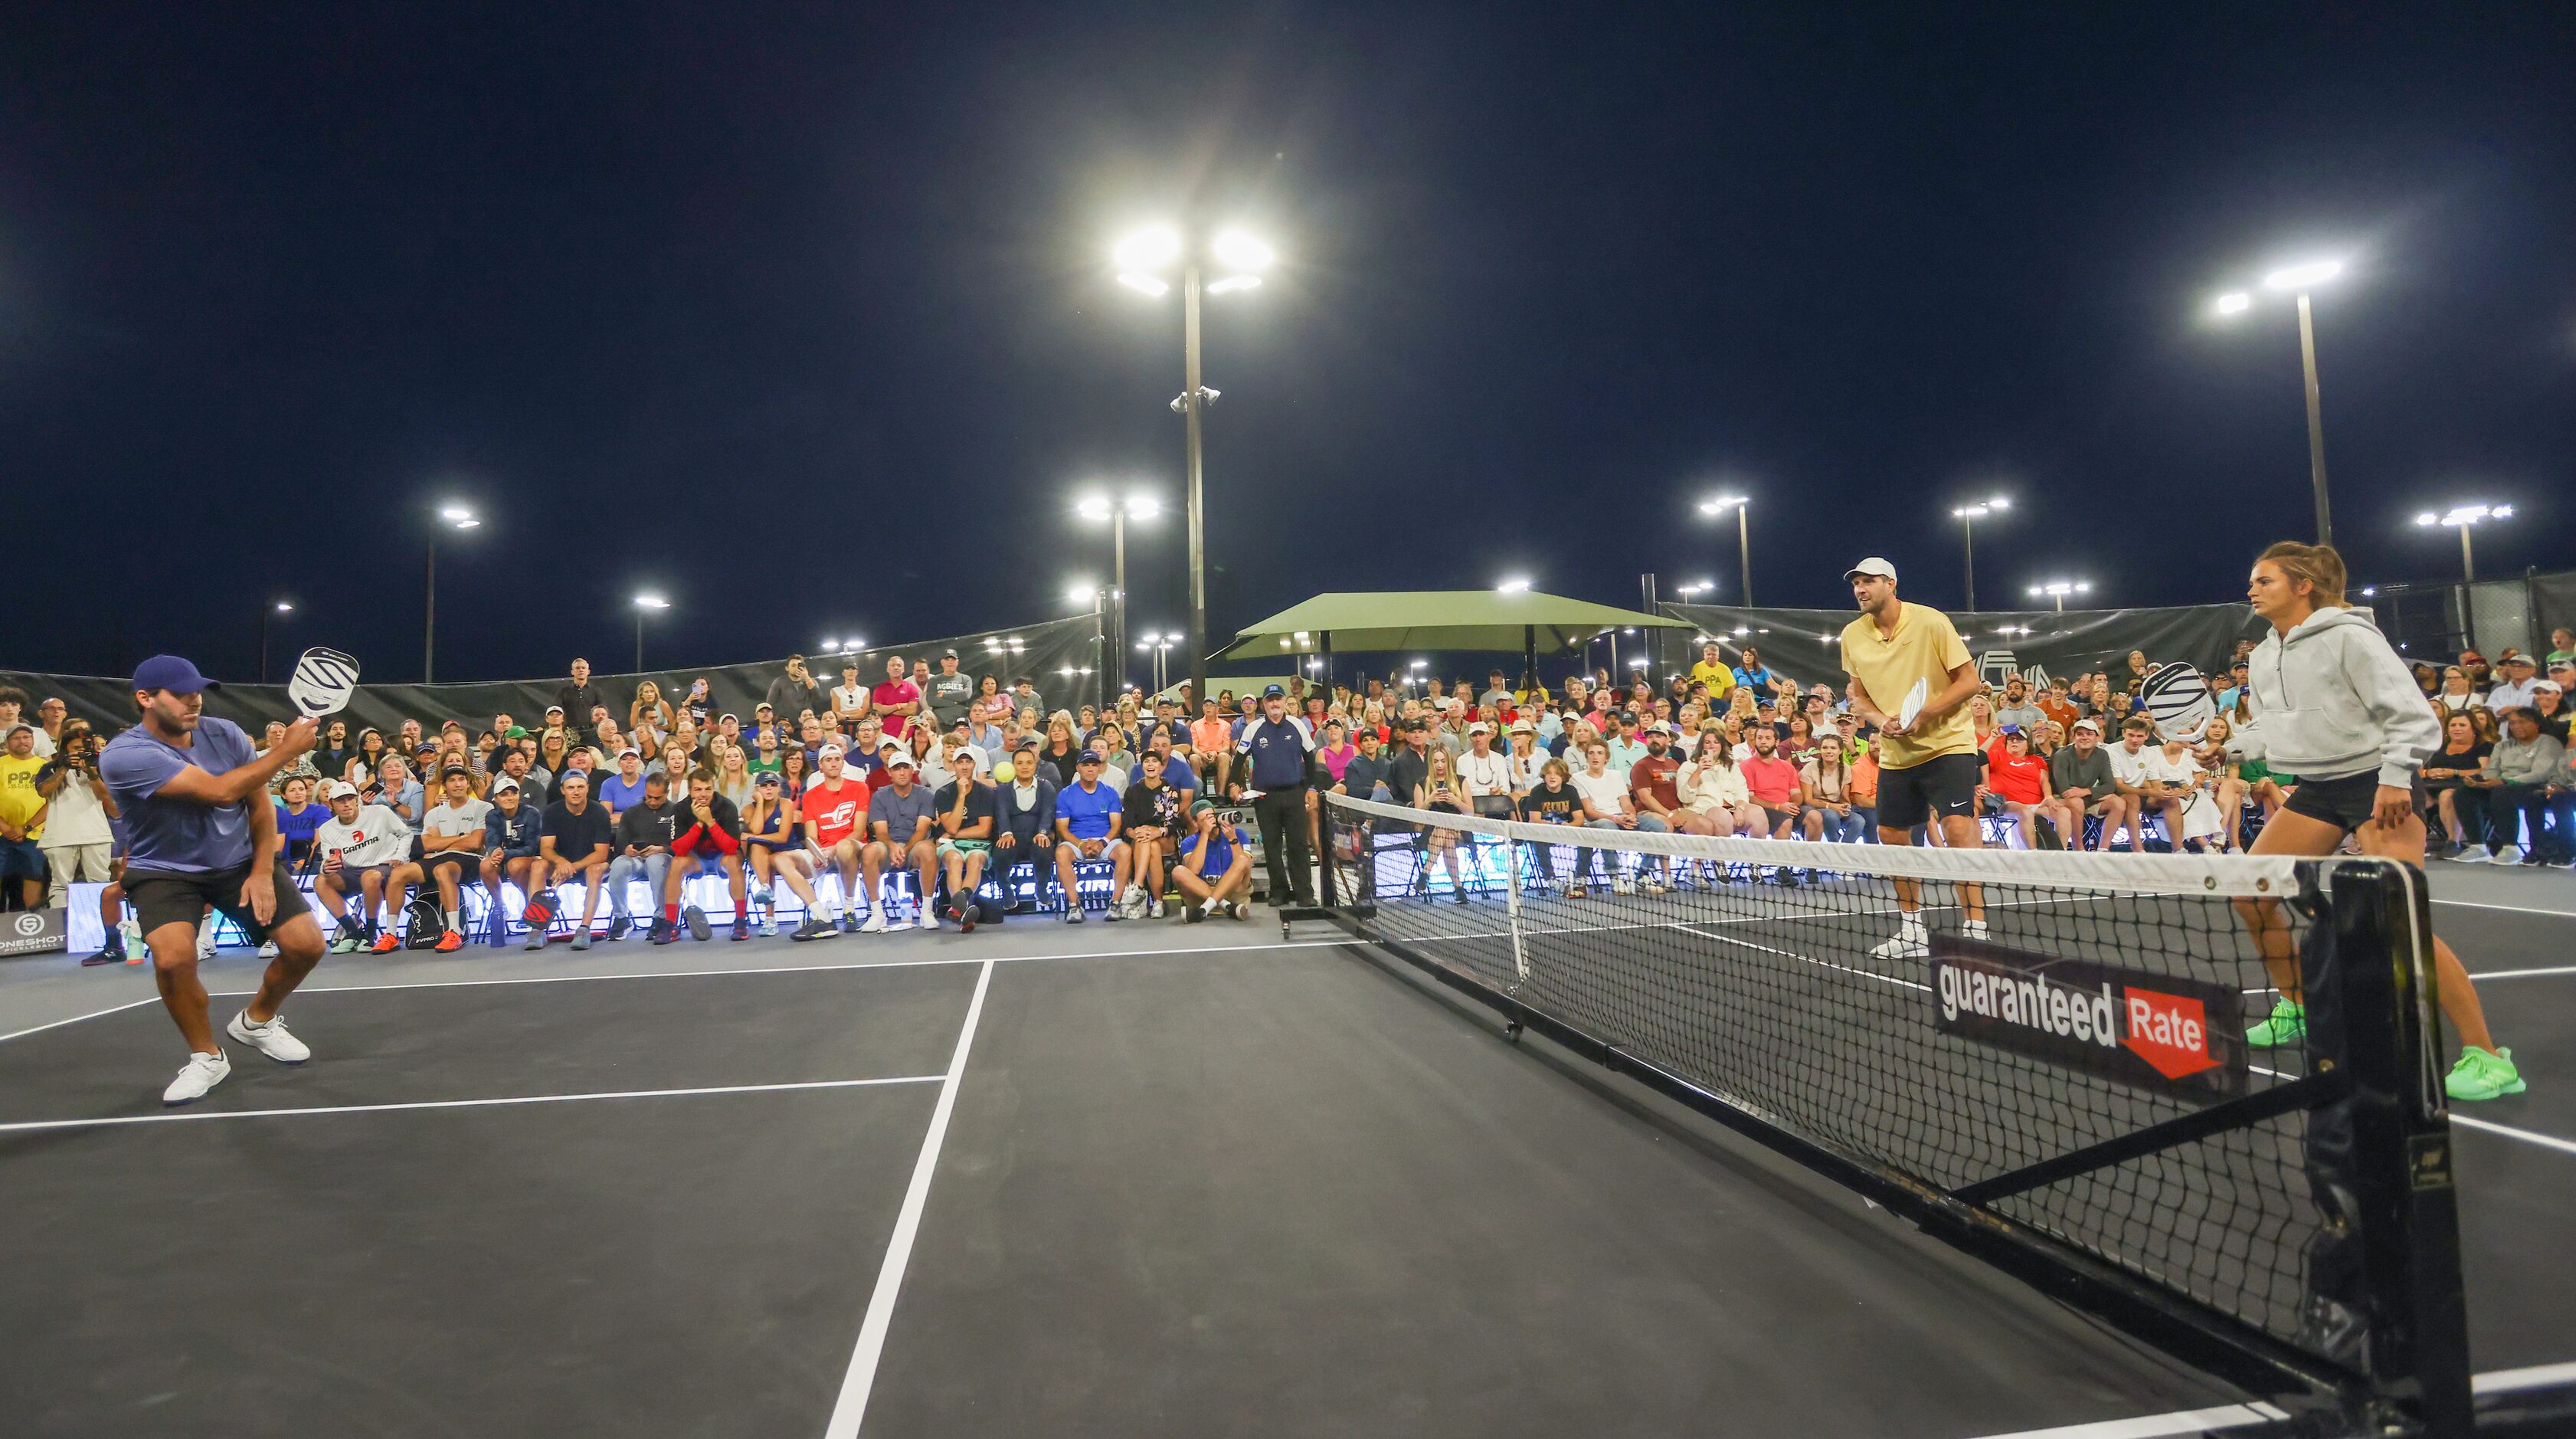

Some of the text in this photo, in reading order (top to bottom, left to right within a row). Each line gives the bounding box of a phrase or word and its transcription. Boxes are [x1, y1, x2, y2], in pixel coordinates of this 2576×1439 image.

[1705, 674, 1722, 684] PPA
[937, 681, 964, 690] AGGIES
[342, 835, 379, 854] GAMMA
[5, 943, 58, 952] PICKLEBALL
[1939, 963, 2203, 1052] guaranteed Rate
